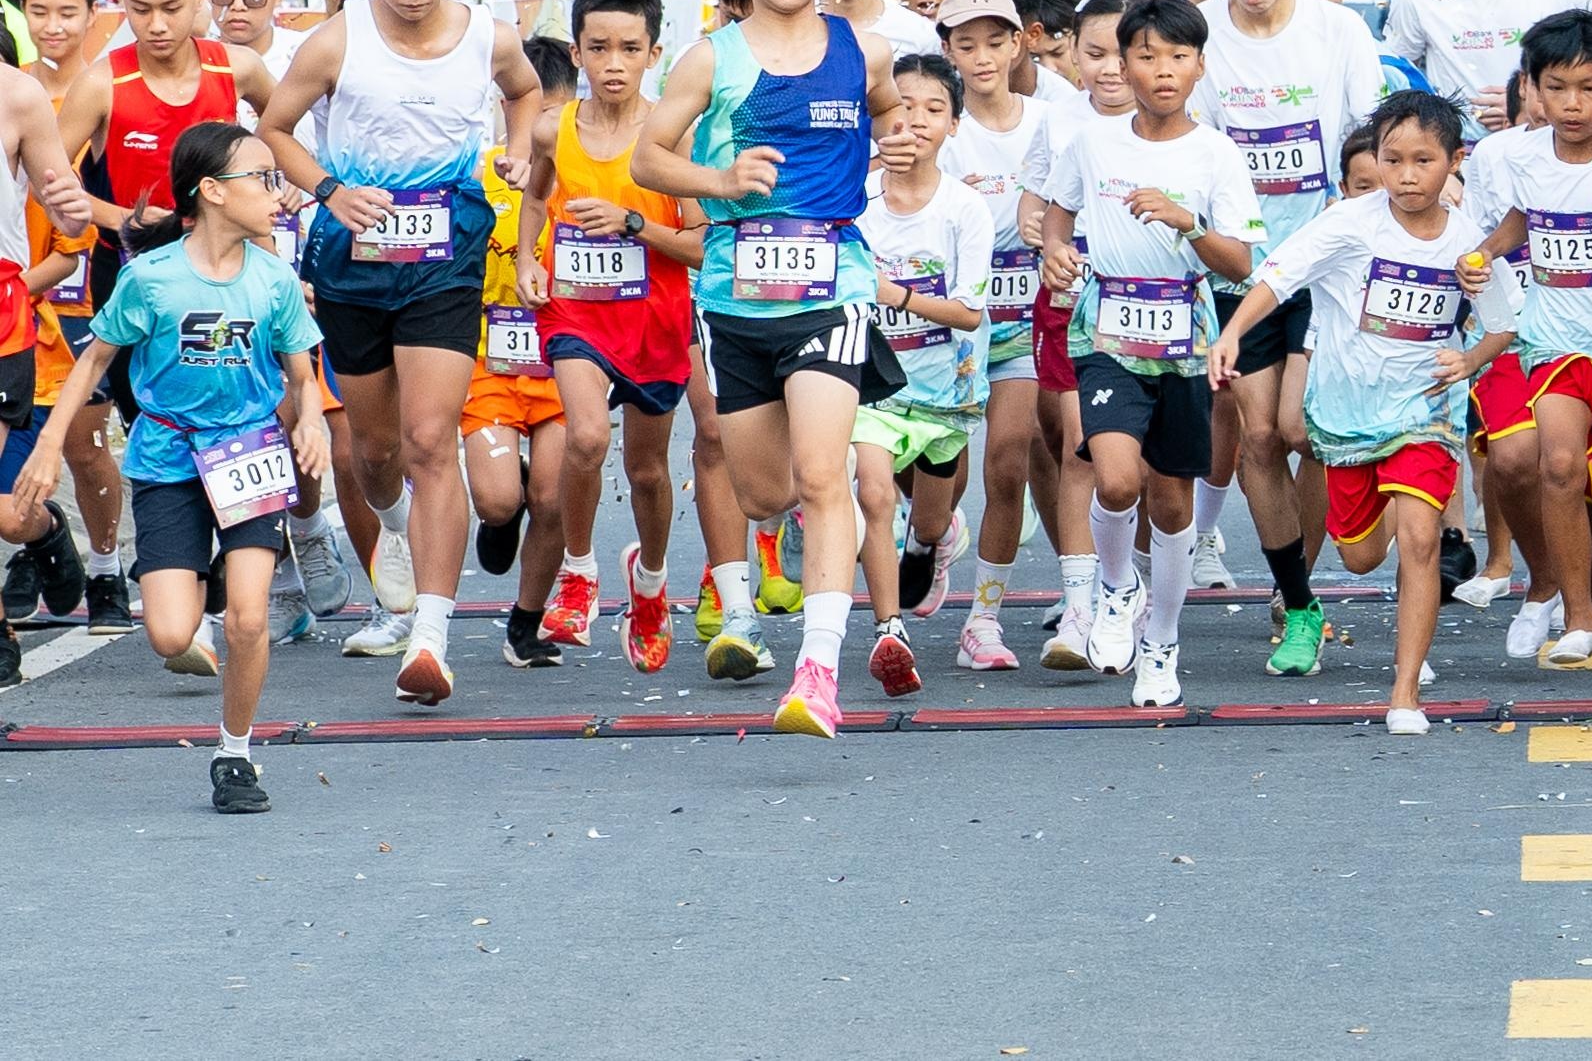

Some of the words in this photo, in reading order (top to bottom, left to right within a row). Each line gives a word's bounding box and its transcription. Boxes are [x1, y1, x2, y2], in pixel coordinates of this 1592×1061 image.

[1231, 86, 1264, 94] HDBank
[810, 108, 838, 121] VUNG
[1247, 148, 1303, 171] 3120
[1301, 179, 1321, 190] 3KM
[376, 213, 433, 235] 3133
[426, 248, 446, 258] 3KM
[571, 250, 623, 274] 3118
[755, 246, 815, 270] 3135
[620, 286, 641, 296] 3KM
[992, 274, 1028, 296] 019
[1388, 288, 1446, 316] 3128
[1120, 306, 1173, 331] 3113
[507, 330, 530, 351] 31
[925, 334, 946, 344] 3KM
[1166, 344, 1187, 355] 3KM
[180, 356, 219, 367] JUST
[223, 356, 252, 366] RUN
[228, 454, 287, 493] 3012
